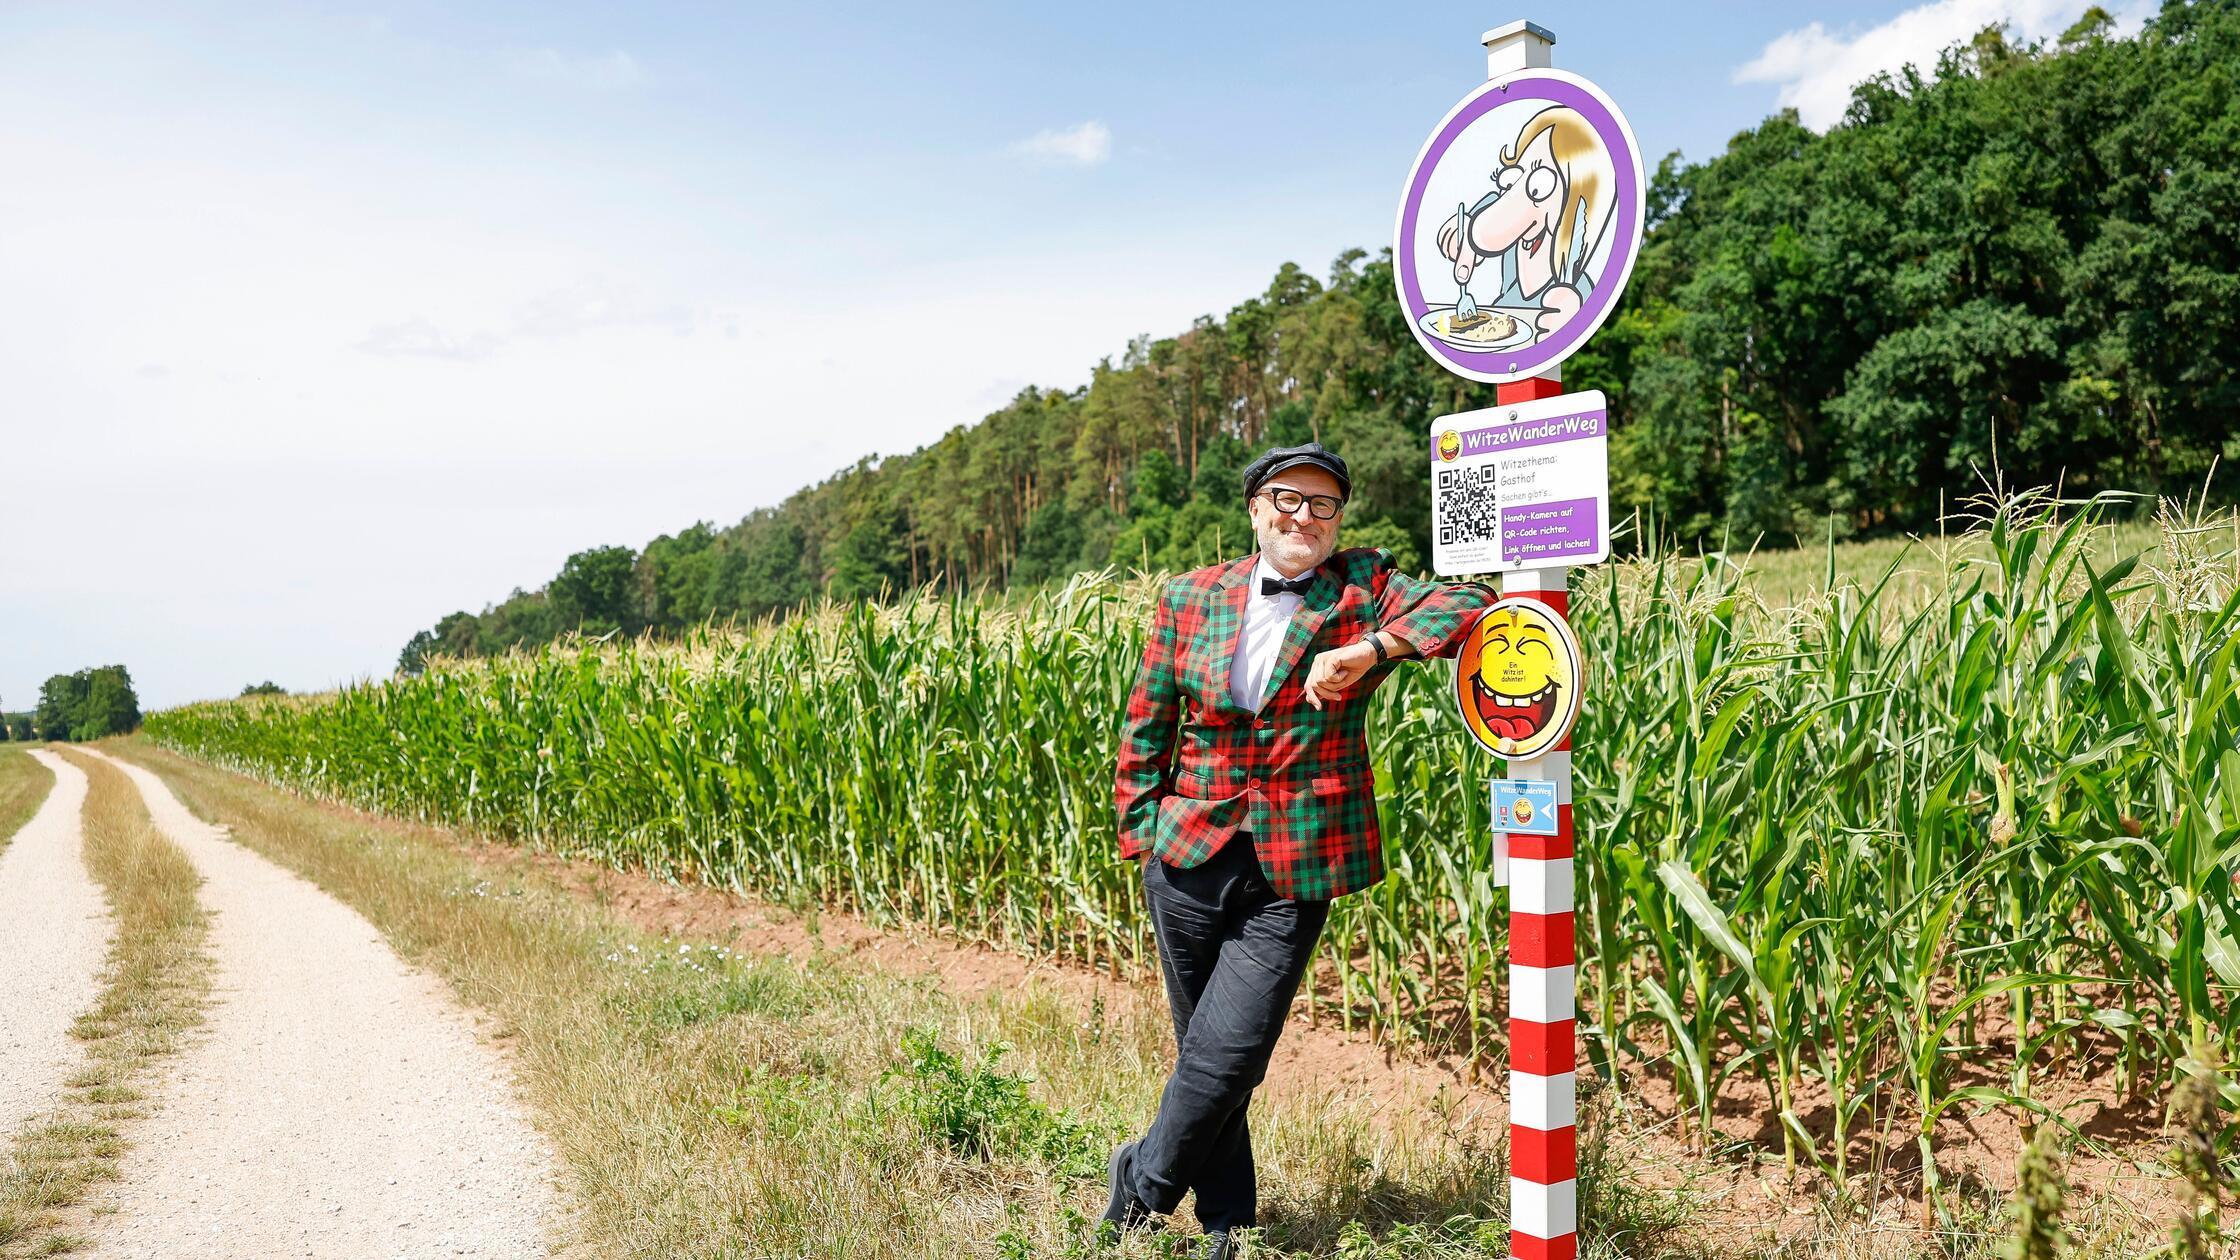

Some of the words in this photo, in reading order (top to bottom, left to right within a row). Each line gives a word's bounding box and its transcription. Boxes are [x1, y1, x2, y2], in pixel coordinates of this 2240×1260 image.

[1467, 416, 1599, 449] WitzeWanderWeg
[1500, 455, 1558, 470] Witzethema:
[1500, 471, 1536, 486] Gasthof
[1500, 492, 1527, 502] Sachen
[1504, 510, 1558, 523] Handy-Kamera
[1560, 507, 1574, 517] auf
[1504, 528, 1538, 540] QR-Code
[1540, 525, 1570, 535] richten,
[1504, 544, 1520, 555] Link
[1521, 542, 1546, 554] öffnen
[1548, 540, 1562, 551] und
[1564, 537, 1591, 550] lachen!
[1508, 661, 1518, 669] Ein
